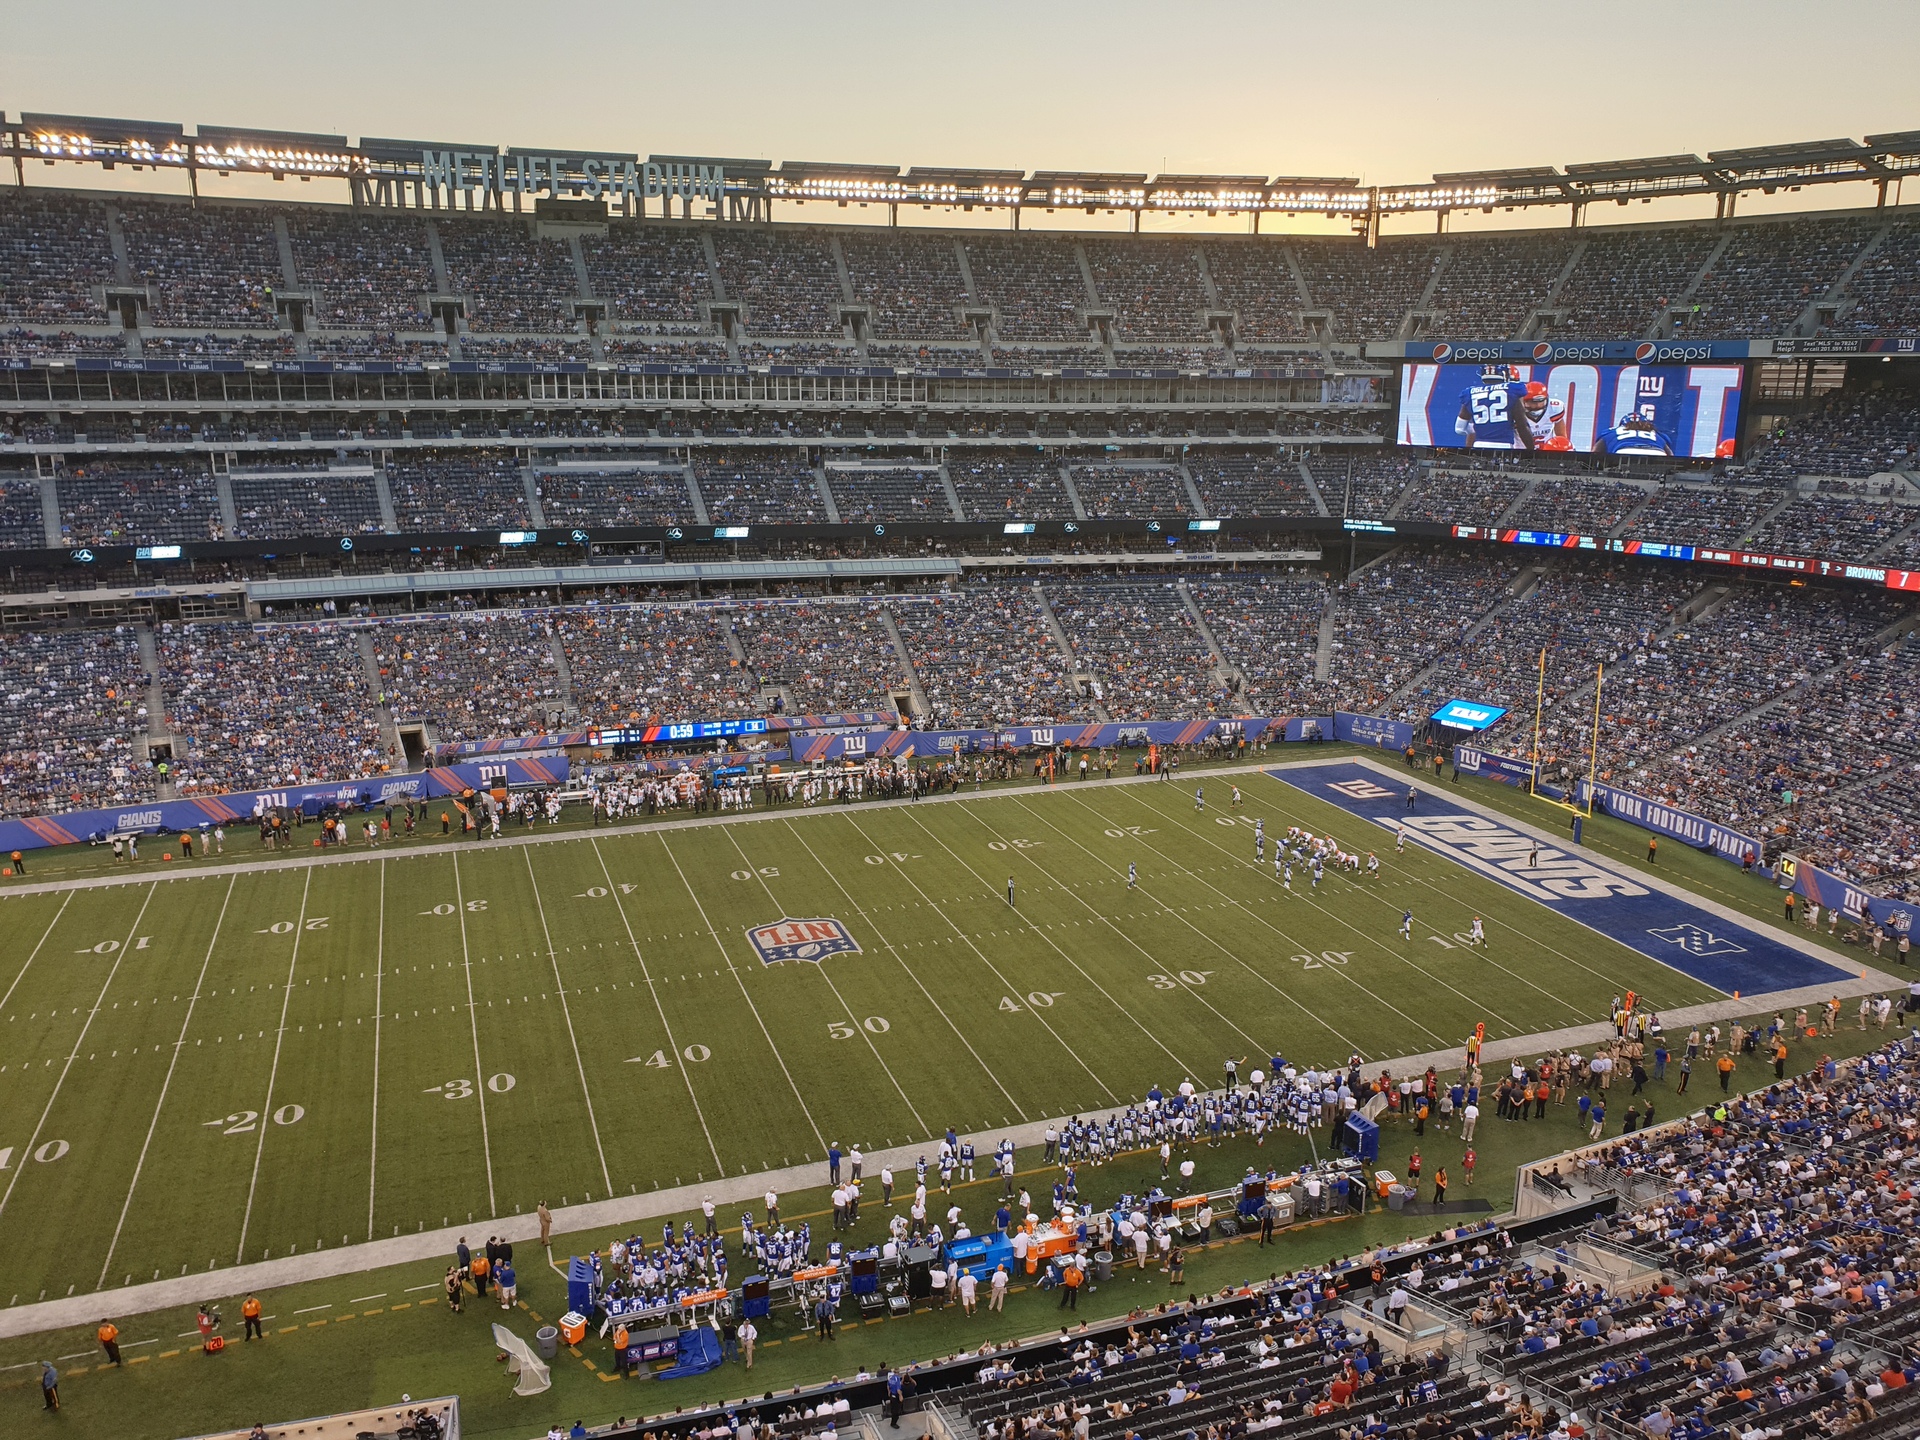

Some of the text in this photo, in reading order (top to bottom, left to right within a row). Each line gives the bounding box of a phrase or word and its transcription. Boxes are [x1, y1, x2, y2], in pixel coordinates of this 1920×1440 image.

[422, 149, 724, 201] METLIFE STADIUM
[1454, 345, 1503, 362] pepsi
[1554, 344, 1604, 362] pepsi
[1657, 344, 1712, 362] pepsi
[1470, 383, 1509, 394] OGLETREE
[1639, 376, 1664, 396] ny
[1471, 389, 1508, 425] 52
[1701, 551, 1731, 561] 2ND DOWN
[1751, 556, 1758, 564] TO
[1759, 557, 1767, 565] GO
[1773, 558, 1796, 568] BALL ON
[1845, 564, 1886, 581] BROWNS
[1899, 571, 1910, 587] 7
[135, 588, 170, 597] MetLife
[670, 724, 693, 739] 0:59
[1000, 733, 1016, 743] WFAN
[1031, 728, 1054, 746] ny
[1117, 727, 1148, 741] GIANTS
[843, 736, 866, 755] ny
[938, 736, 969, 750] GIANTS
[1460, 748, 1481, 771] ny
[337, 786, 357, 800] WFAN
[381, 780, 419, 796] GIANTS
[117, 811, 162, 829] GIANTS
[1612, 791, 1642, 819] YORK
[1646, 805, 1704, 842] FOOTBALL
[1380, 815, 1651, 899] GIANTS
[1782, 860, 1795, 876] 14
[757, 922, 838, 946] NFL
[1427, 931, 1481, 950] 10
[1290, 950, 1349, 970] 20
[1147, 970, 1206, 990] 30
[998, 991, 1054, 1013] 40
[827, 1016, 890, 1040] 50
[645, 1043, 711, 1069] 40
[444, 1072, 516, 1100] 30
[223, 1104, 305, 1135] 20
[0, 1139, 70, 1170] 10
[830, 1246, 840, 1254] 85
[831, 1288, 840, 1296] 47
[612, 1304, 622, 1312] 61
[632, 1303, 643, 1311] 73
[211, 1338, 222, 1349] 20
[1425, 1388, 1438, 1403] 89
